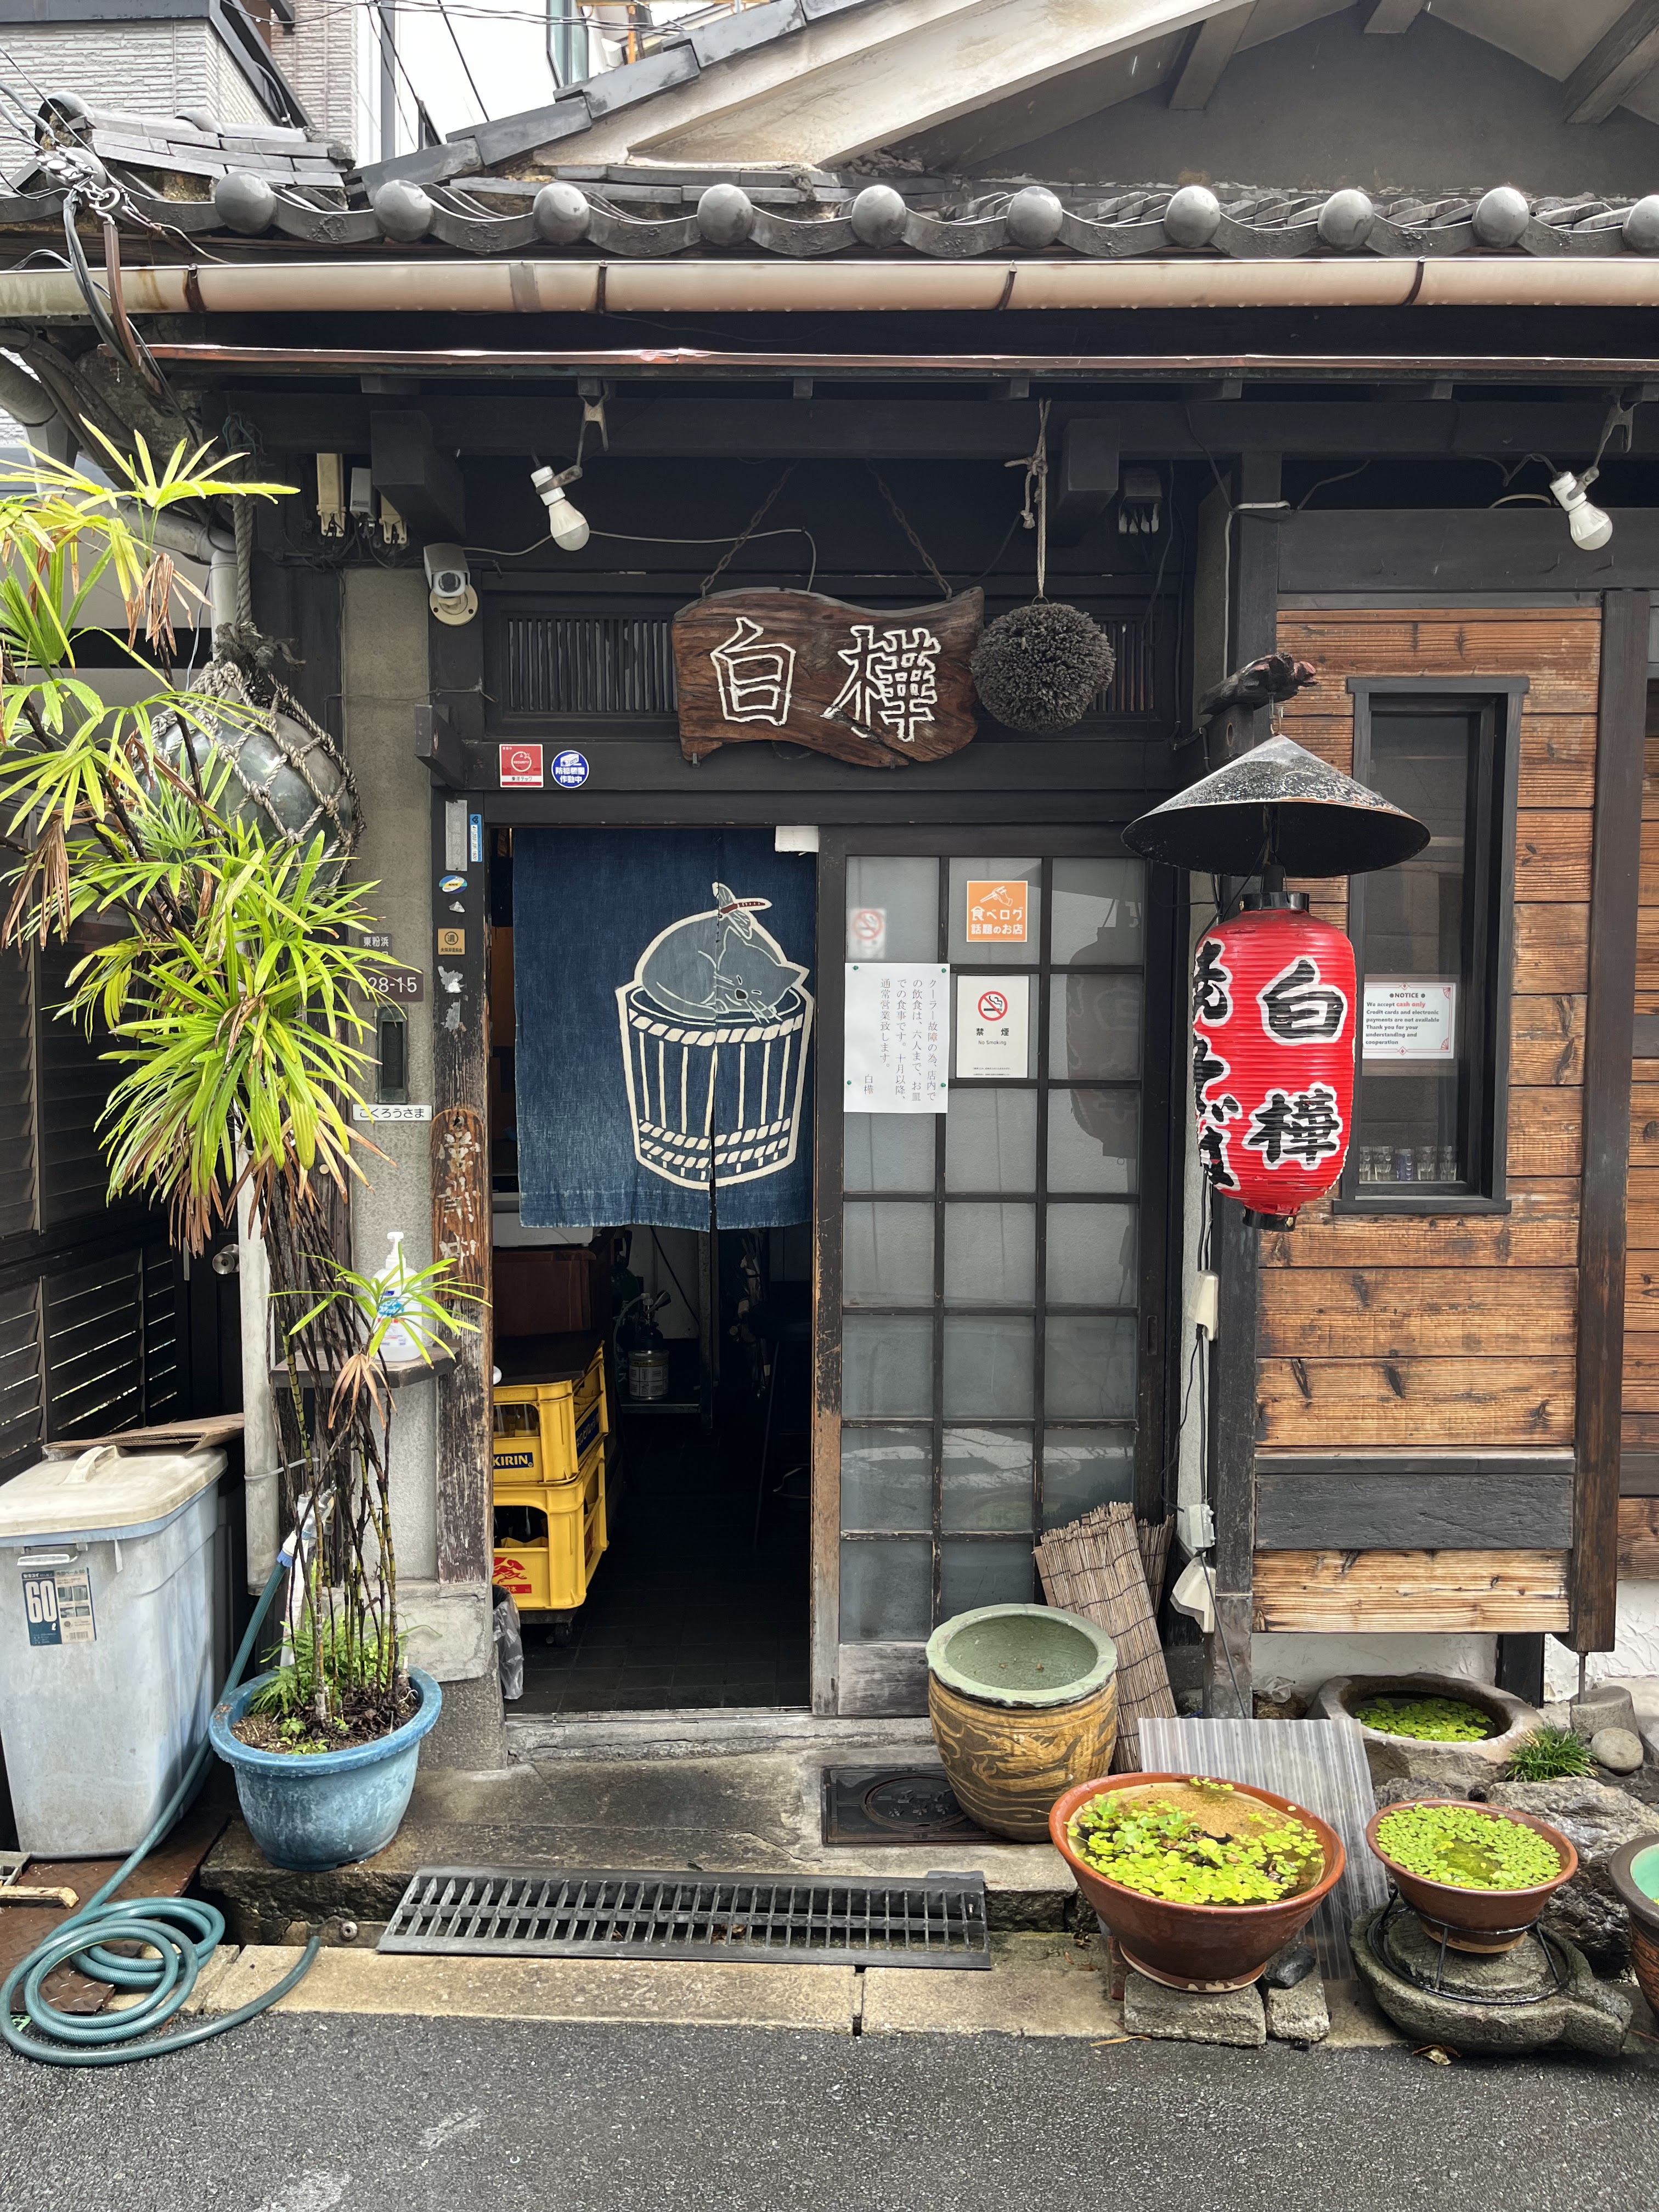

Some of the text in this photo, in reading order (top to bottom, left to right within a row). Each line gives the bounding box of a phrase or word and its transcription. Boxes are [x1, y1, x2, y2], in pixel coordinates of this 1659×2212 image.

[560, 775, 582, 783] 作動中
[970, 906, 1024, 922] 食べログ
[970, 924, 1023, 935] 話題のお店
[363, 936, 389, 947] 東粉浜
[368, 977, 417, 993] 28-15
[879, 979, 891, 1068] 通常営業致します。
[494, 1454, 528, 1467] KIRIN
[25, 1580, 58, 1623] 60
